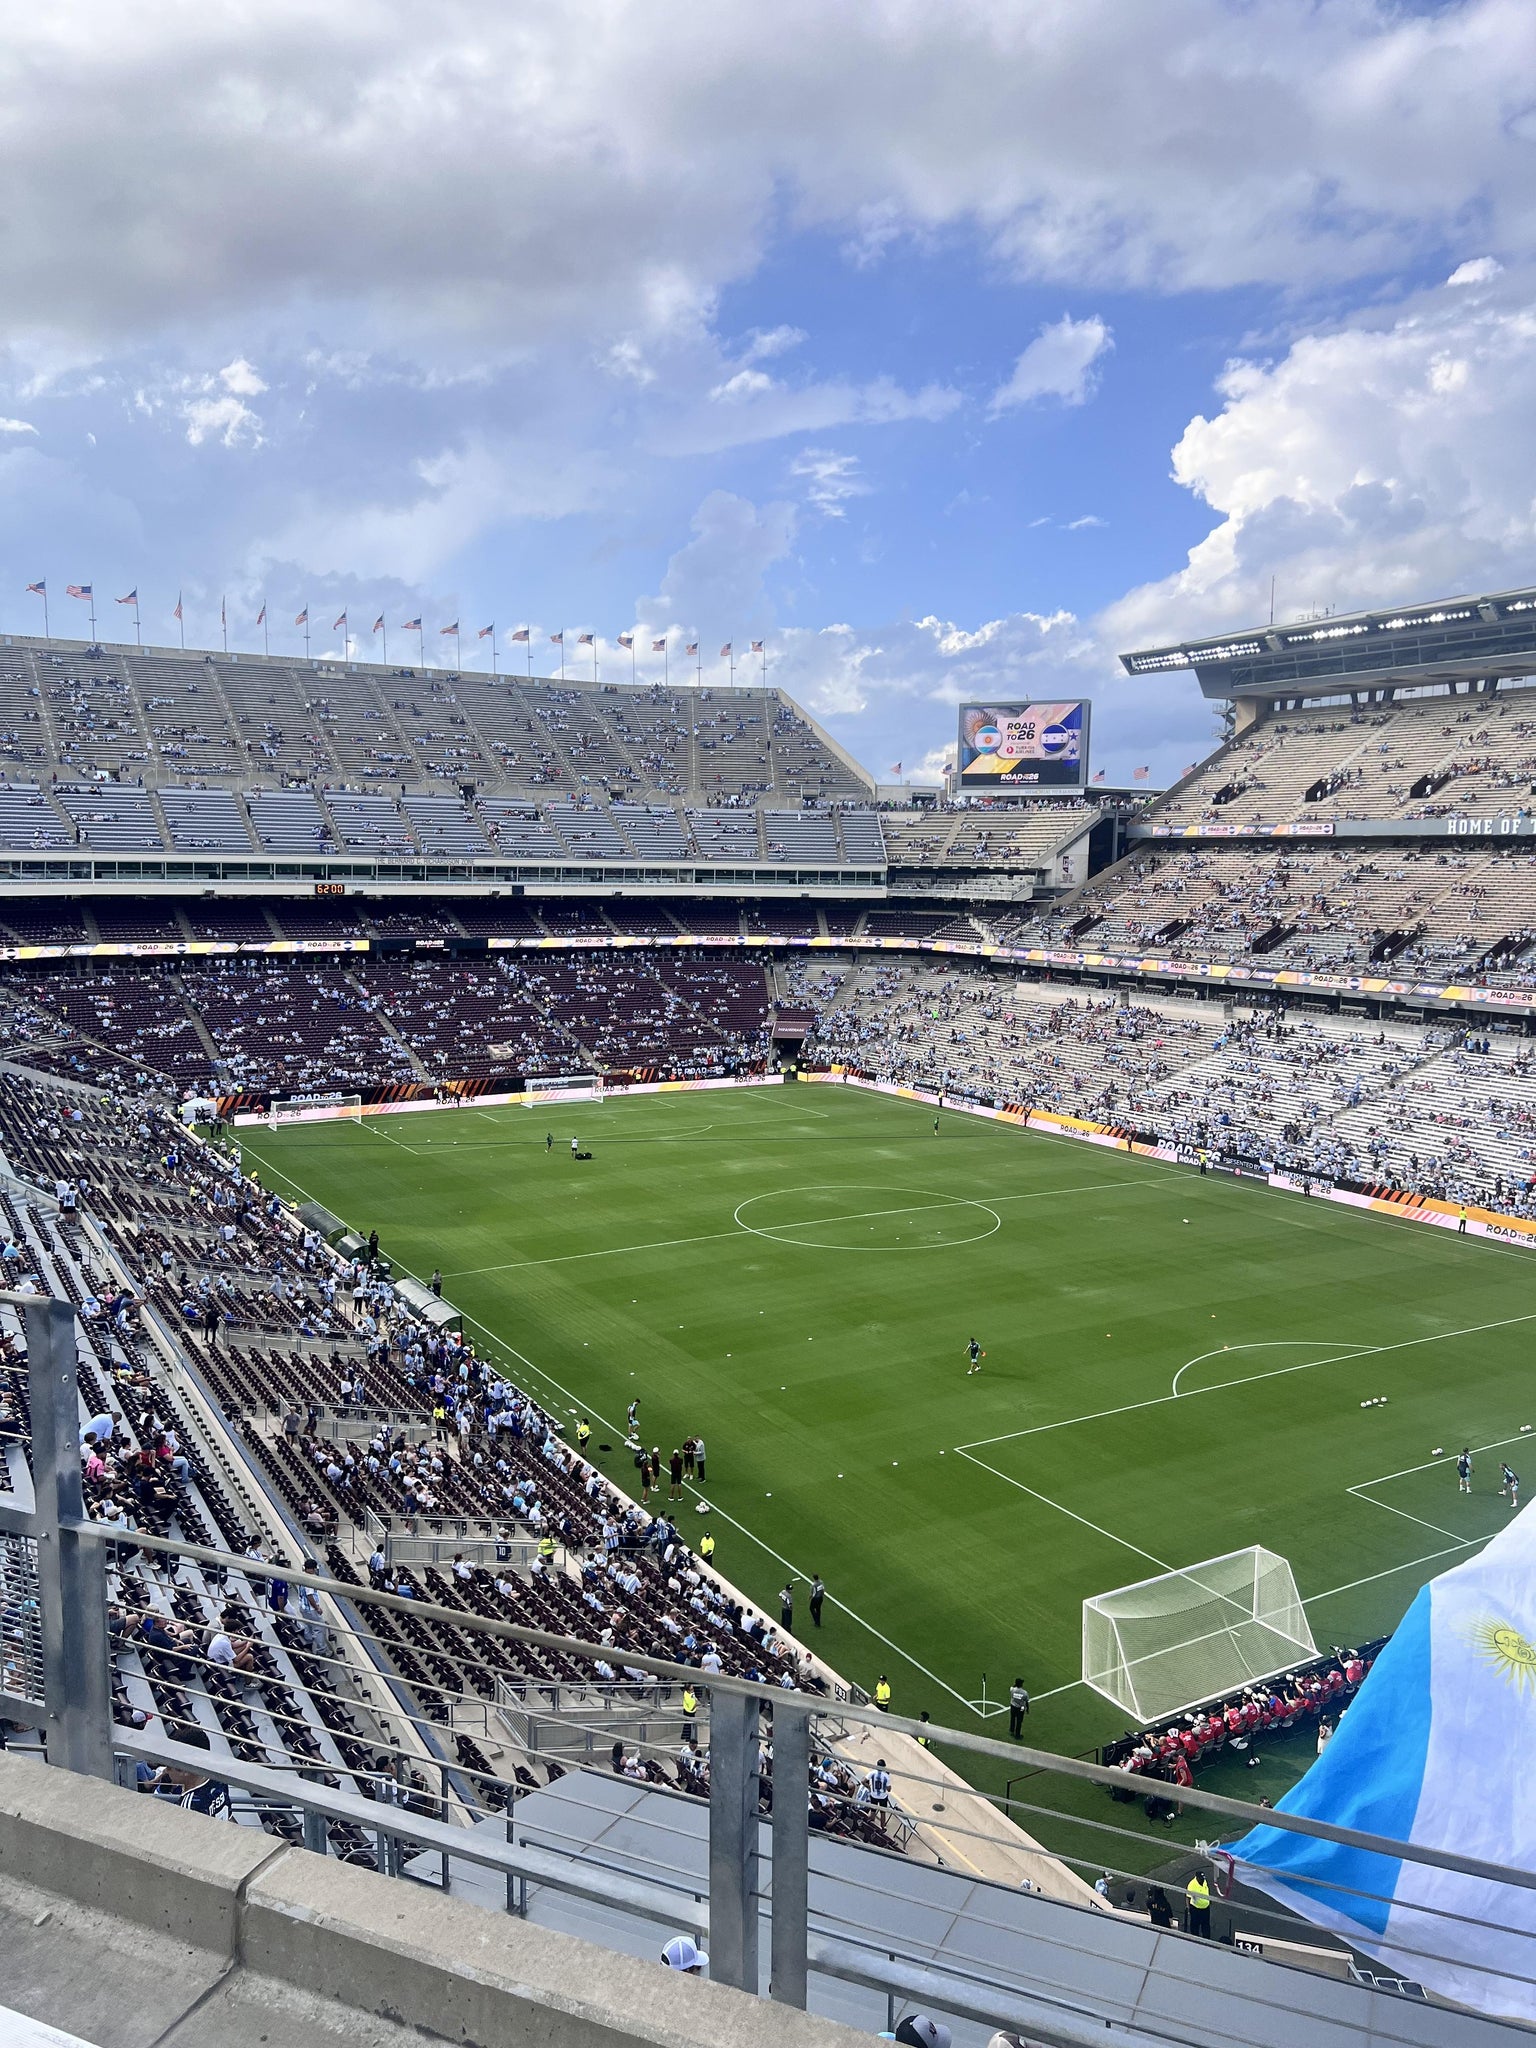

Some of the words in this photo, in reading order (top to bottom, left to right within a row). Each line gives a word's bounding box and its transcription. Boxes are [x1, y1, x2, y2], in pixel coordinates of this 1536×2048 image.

[1017, 730, 1035, 740] 26
[1448, 819, 1492, 834] HOME
[1501, 819, 1521, 834] OF
[1490, 991, 1514, 1000] ROAD
[1521, 993, 1533, 1001] 26
[876, 1074, 898, 1086] ROAD
[904, 1081, 914, 1090] 26
[290, 1094, 320, 1102] ROAD
[258, 1111, 282, 1120] ROAD
[1060, 1124, 1077, 1134] ROAD
[1157, 1139, 1193, 1155] ROAD
[1204, 1150, 1221, 1161] 26
[1223, 1157, 1253, 1168] PRESENTED
[1179, 1155, 1199, 1166] ROAD
[1277, 1169, 1304, 1180] TURKISH
[1289, 1180, 1313, 1190] ROD
[1486, 1224, 1517, 1238] ROAD
[499, 1546, 506, 1556] 10
[1237, 1941, 1260, 1954] 134
